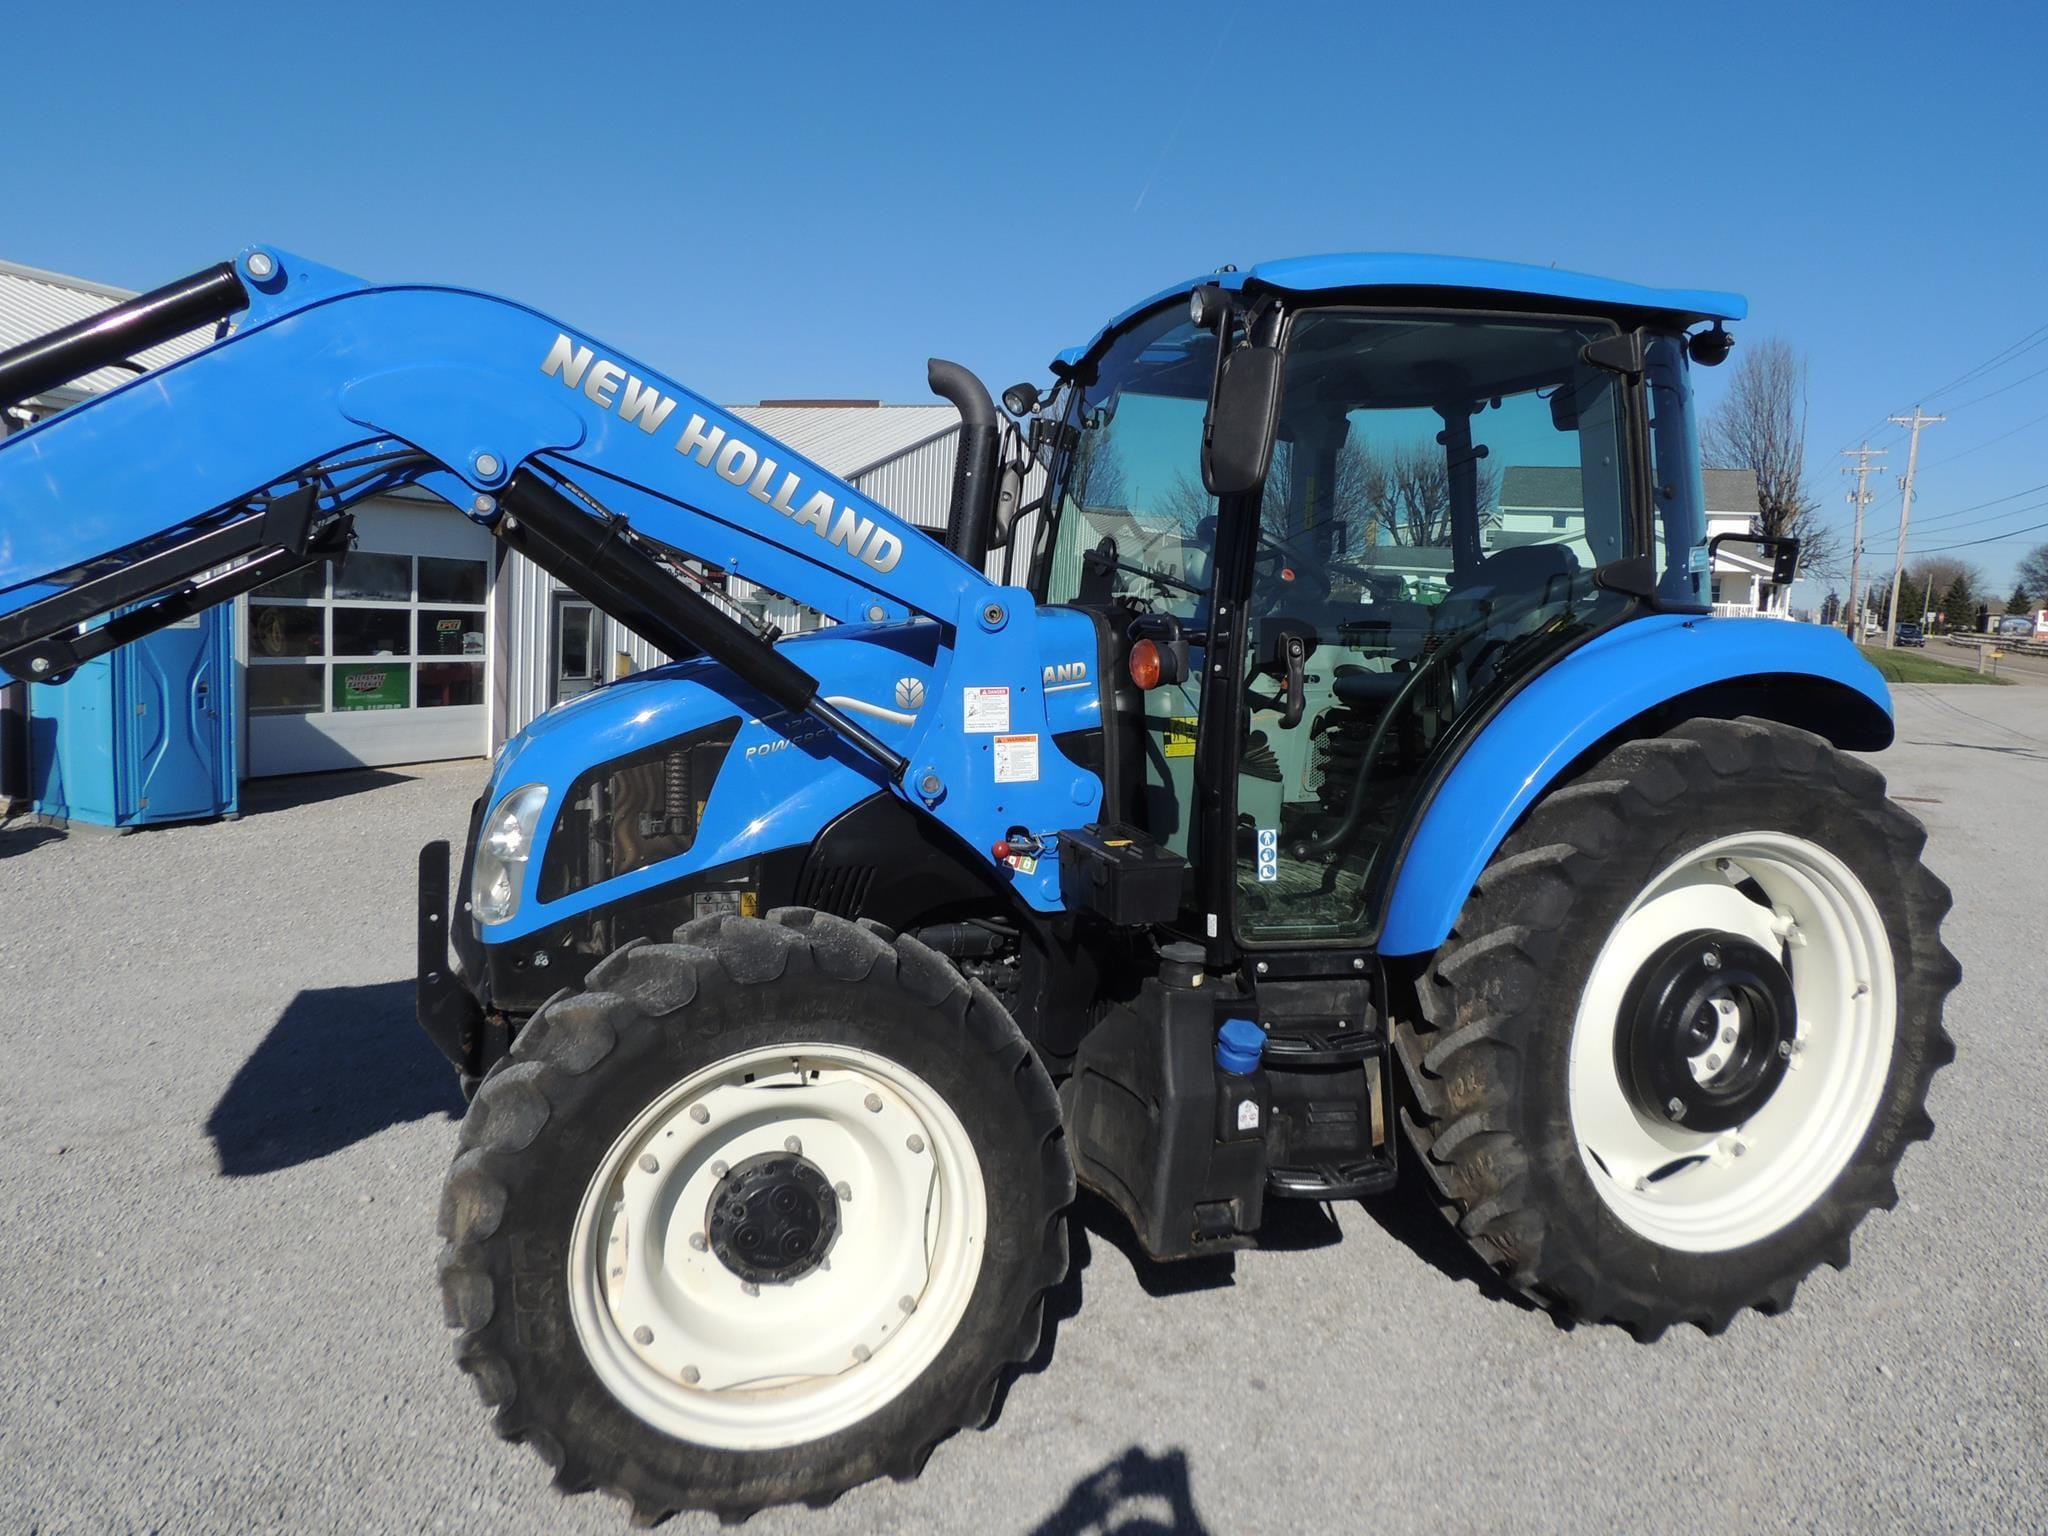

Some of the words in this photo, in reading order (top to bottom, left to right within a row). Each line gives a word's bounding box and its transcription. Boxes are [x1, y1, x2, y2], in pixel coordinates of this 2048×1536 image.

[540, 333, 678, 435] NEW
[674, 413, 903, 574] HOLLAND
[1043, 661, 1087, 684] AND
